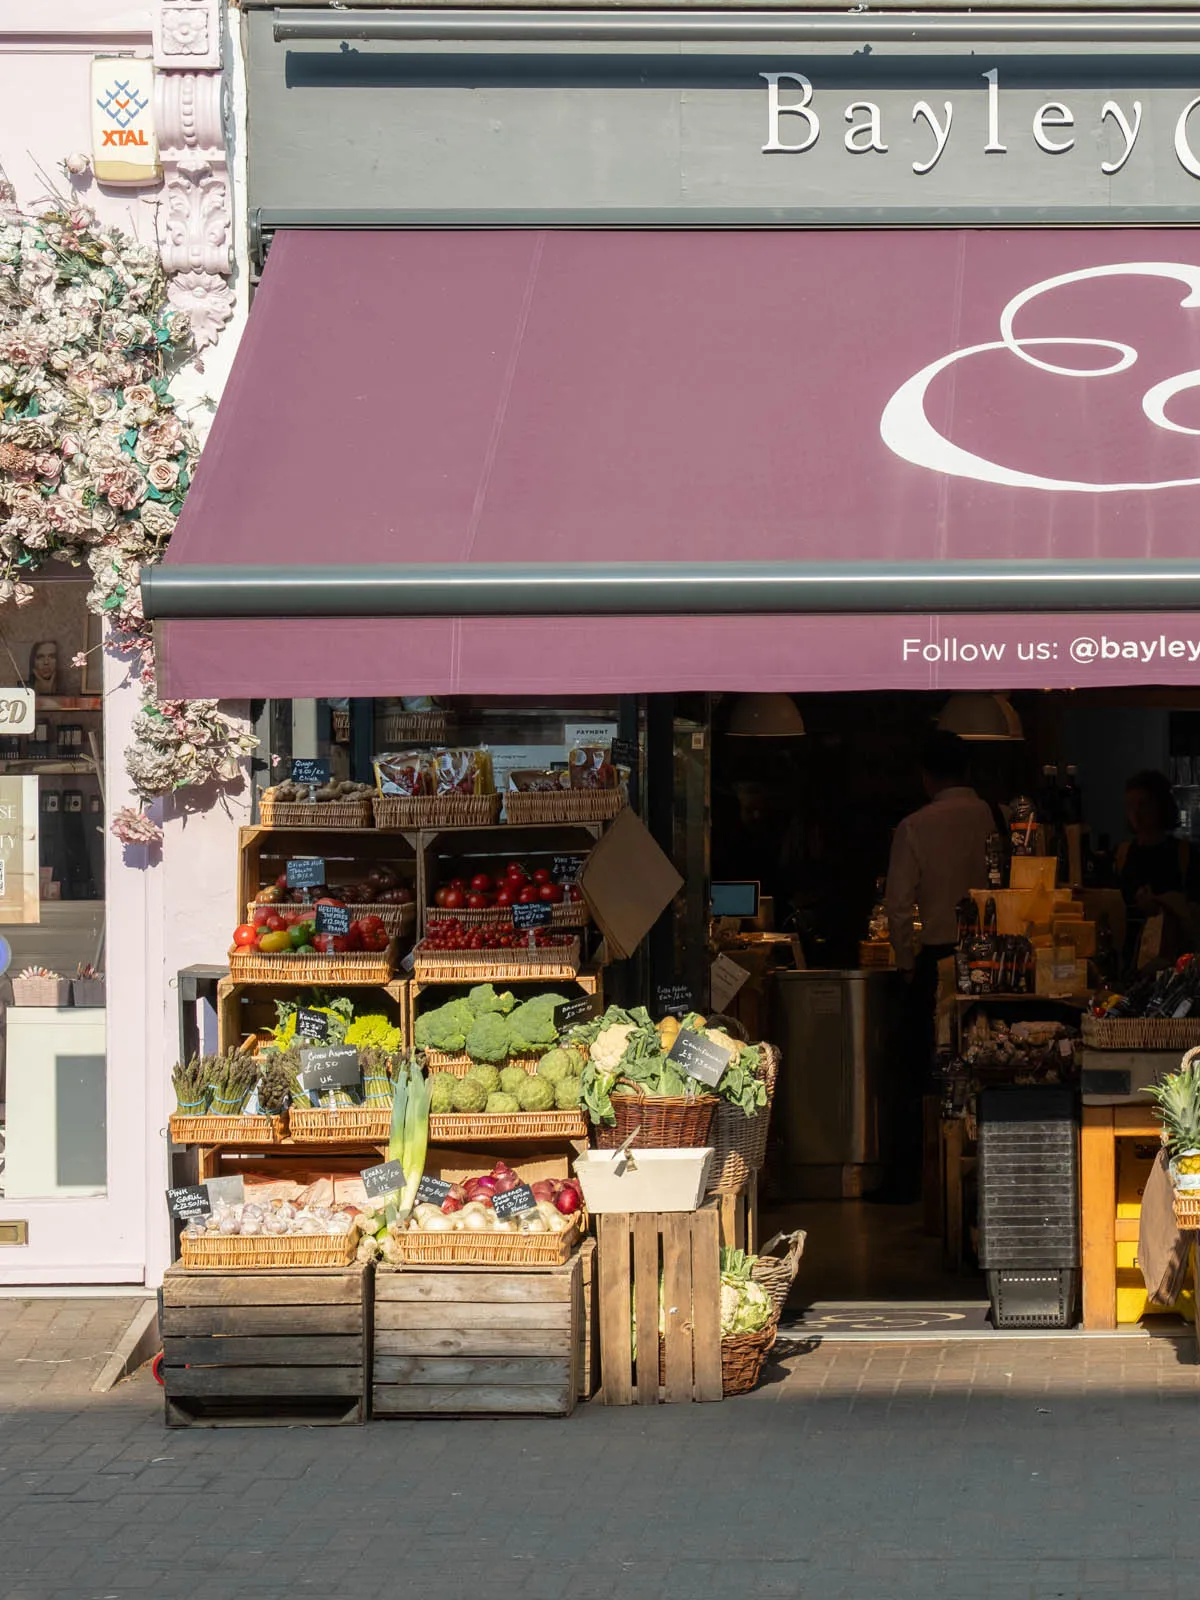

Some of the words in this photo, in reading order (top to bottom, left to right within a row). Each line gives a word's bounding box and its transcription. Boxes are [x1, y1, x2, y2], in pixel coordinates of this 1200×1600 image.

[758, 68, 1142, 175] Bayley
[101, 129, 149, 147] XTAL
[902, 637, 1006, 662] Follow
[1016, 638, 1060, 661] us:
[303, 1060, 339, 1075] £12.50
[320, 1075, 334, 1084] UK
[168, 1188, 189, 1199] PINK
